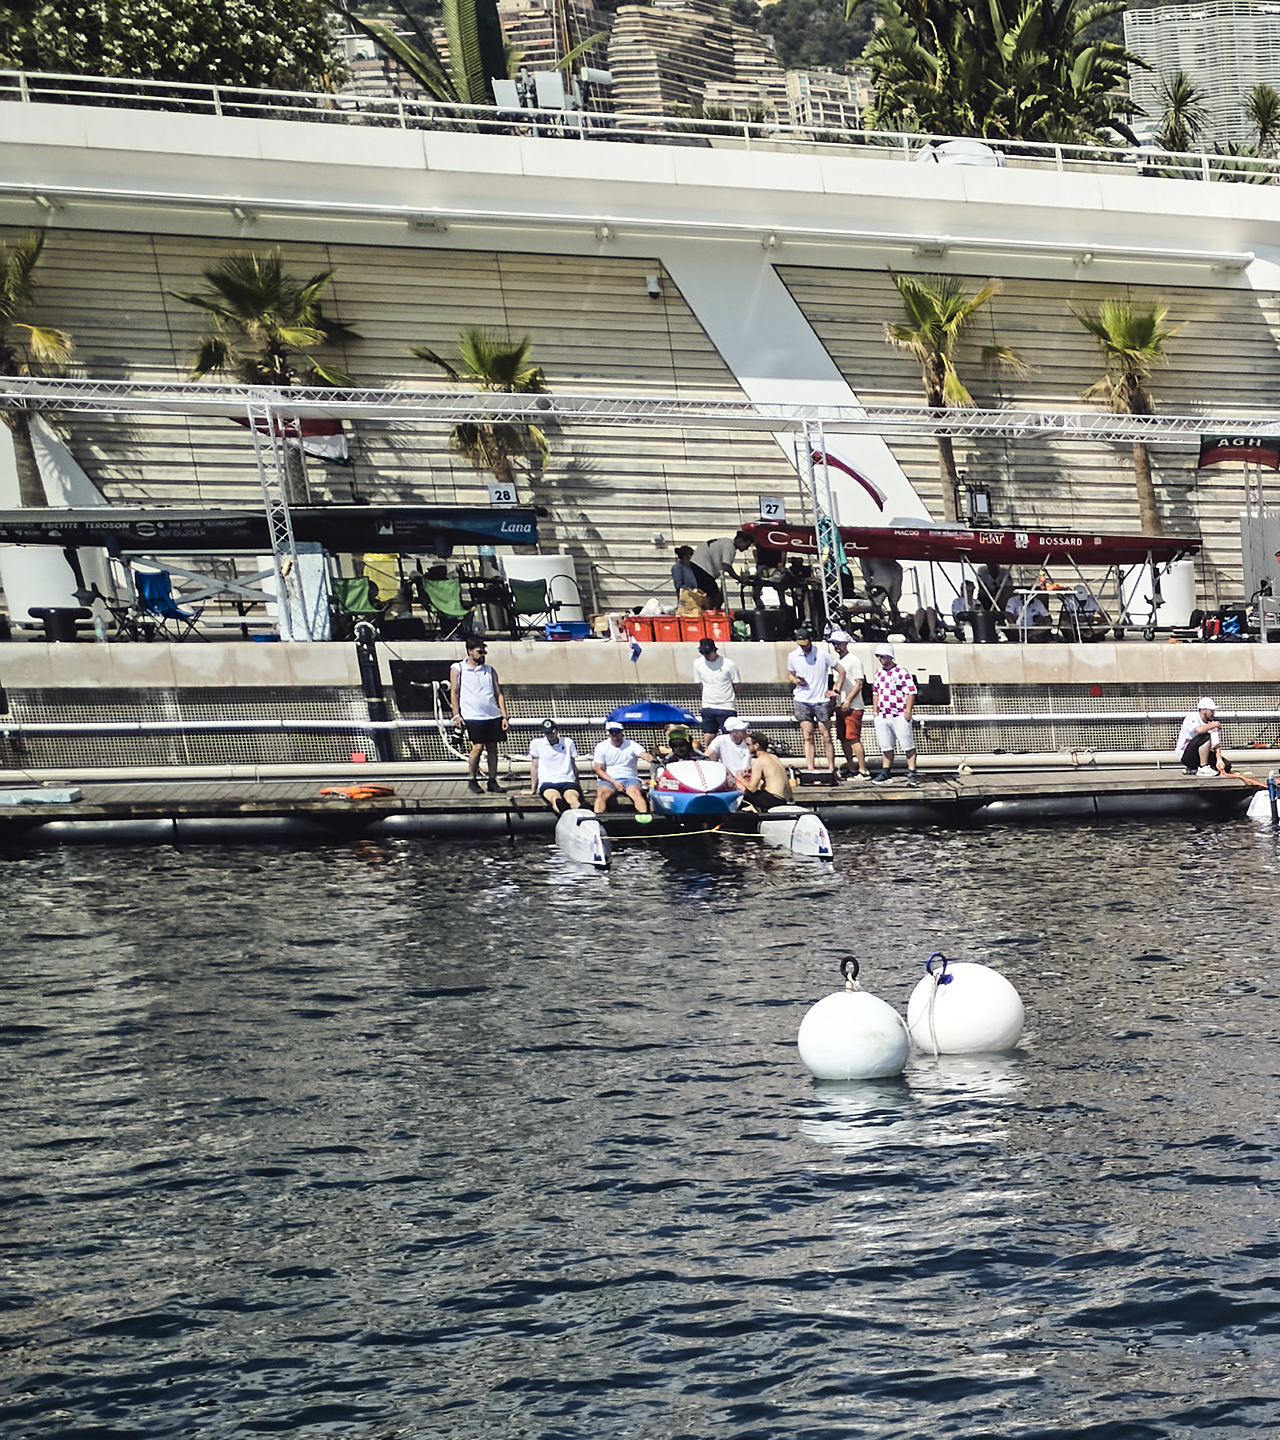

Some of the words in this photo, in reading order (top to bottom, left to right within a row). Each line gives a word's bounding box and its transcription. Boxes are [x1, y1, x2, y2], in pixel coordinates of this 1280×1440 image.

[1217, 437, 1262, 447] AGH
[494, 490, 511, 501] 28
[765, 504, 779, 514] 27
[501, 521, 531, 533] Lana
[1039, 537, 1083, 546] BOSSARD
